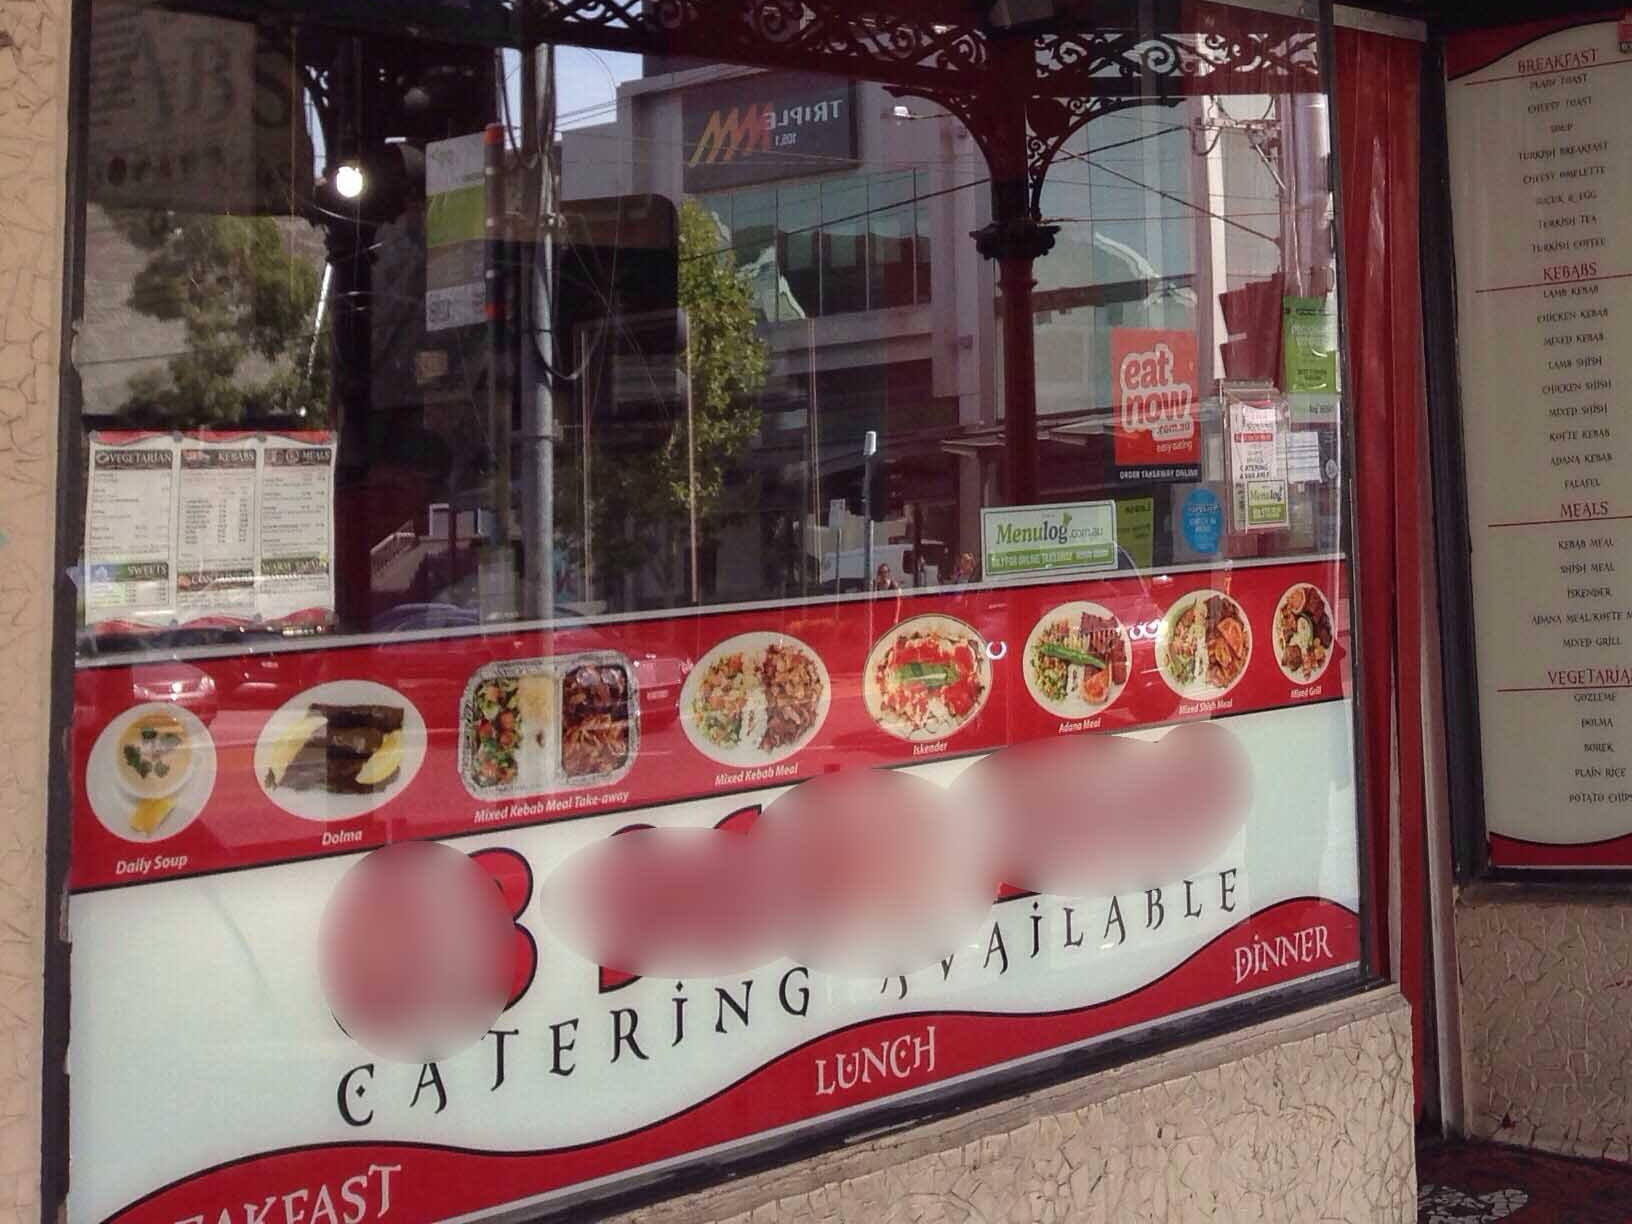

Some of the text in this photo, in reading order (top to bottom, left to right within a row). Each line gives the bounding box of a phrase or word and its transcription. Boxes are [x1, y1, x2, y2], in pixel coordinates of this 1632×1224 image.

[1517, 47, 1600, 74] BREAKFAST
[1542, 261, 1598, 282] KEBABS
[1123, 347, 1171, 389] eat
[1125, 389, 1189, 426] now
[1559, 501, 1610, 520] MEALS
[1058, 718, 1101, 734] Adana Meal
[912, 740, 948, 755] Iskender
[714, 762, 799, 786] Mixed Kebab Meal
[474, 790, 630, 824] Mixed Kebab Meal Take-away
[321, 829, 363, 846] Dolma
[116, 853, 188, 875] Daily Soup
[880, 867, 1240, 1000] AILABLE
[814, 1025, 937, 1097] LUNCH
